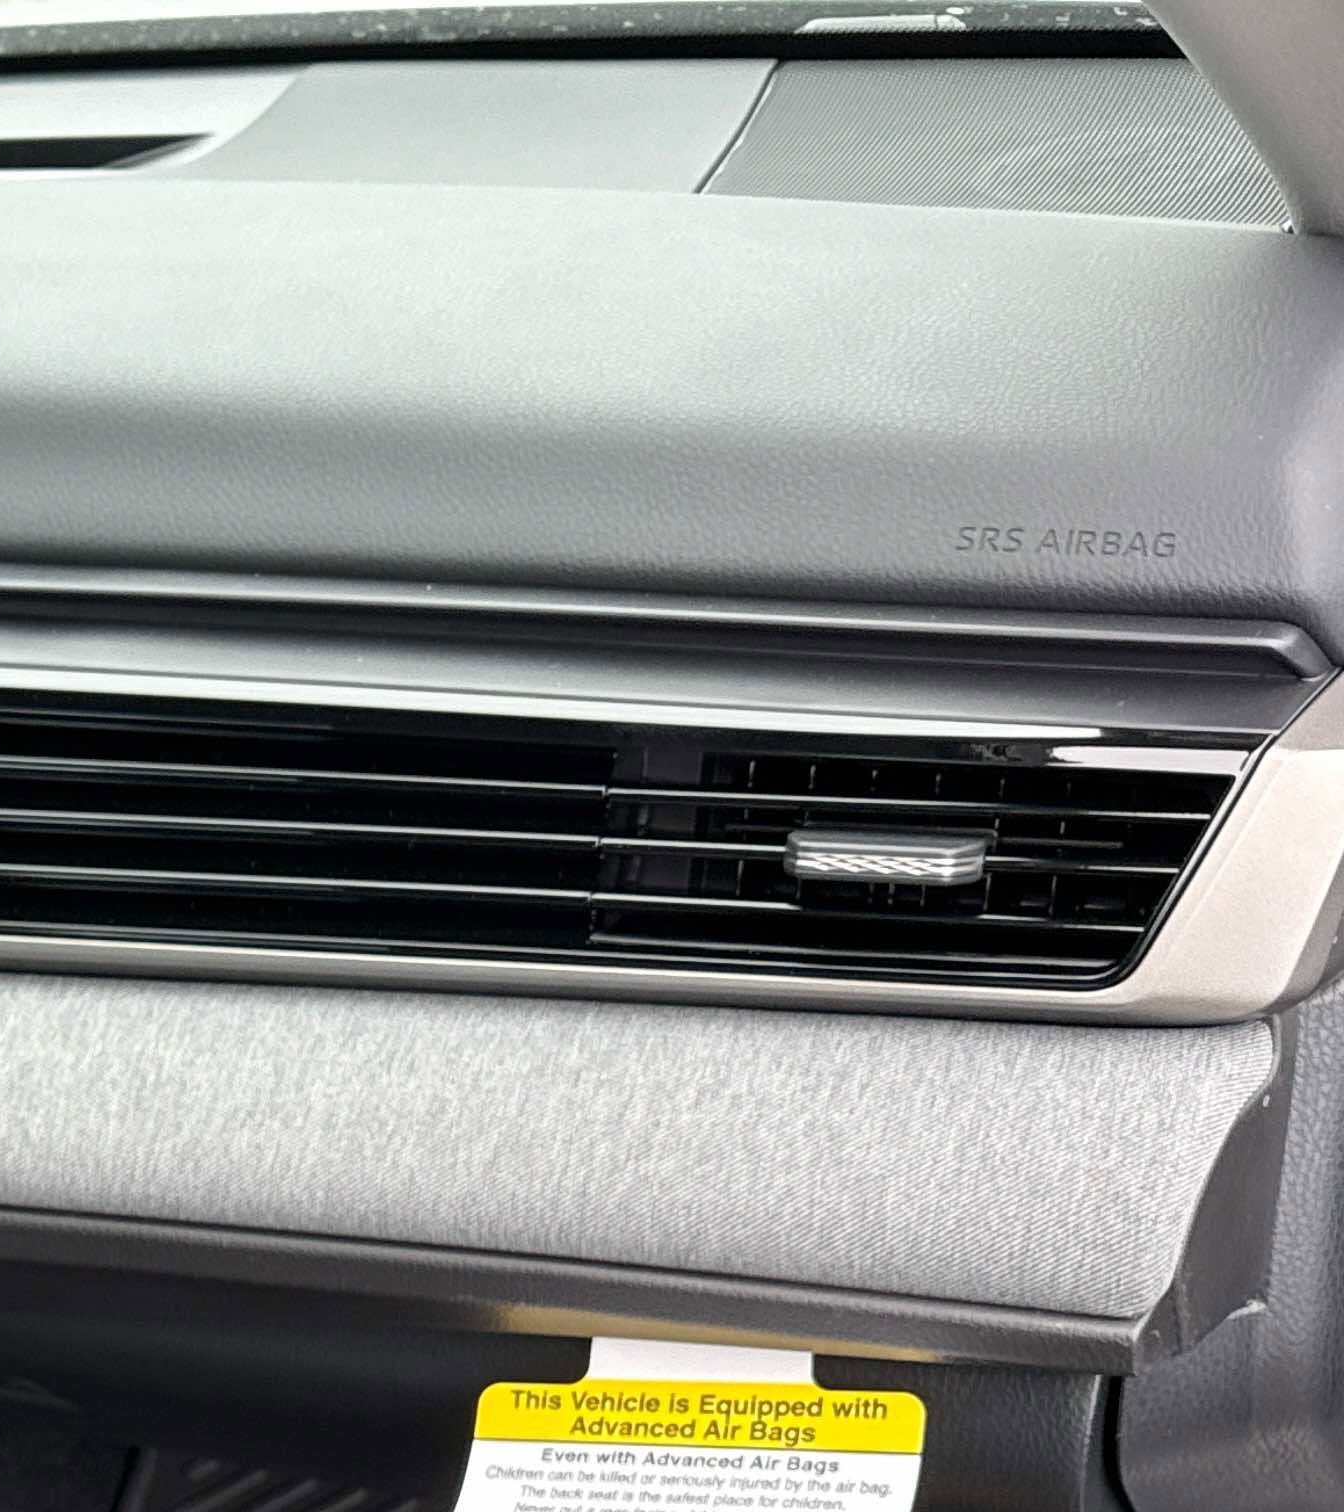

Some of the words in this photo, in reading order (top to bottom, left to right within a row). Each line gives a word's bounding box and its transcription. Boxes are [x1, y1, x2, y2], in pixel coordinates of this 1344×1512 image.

[956, 526, 1024, 552] SRS
[1037, 528, 1177, 558] AIRBAG
[511, 1389, 562, 1410] This
[570, 1391, 660, 1413] Vehicle
[669, 1393, 690, 1414] is
[699, 1394, 824, 1423] Equipped
[832, 1397, 888, 1419] with
[569, 1416, 696, 1438] Advanced
[704, 1419, 742, 1441] Air
[750, 1420, 816, 1447] Bags
[541, 1448, 588, 1463] Even
[596, 1449, 636, 1465] with
[642, 1451, 744, 1469] Advanced
[750, 1455, 781, 1471] Air
[786, 1456, 841, 1476] Bags
[486, 1464, 544, 1481] Children
[548, 1470, 573, 1481] can
[577, 1470, 595, 1482] be
[599, 1470, 636, 1484] killed
[640, 1474, 655, 1485] or
[659, 1475, 724, 1491] seriously
[730, 1476, 780, 1492] injured
[784, 1478, 803, 1493] by
[808, 1478, 831, 1492] the
[836, 1480, 855, 1493] air
[860, 1481, 893, 1498] bag.
[520, 1485, 546, 1498] The
[550, 1486, 583, 1500] back
[588, 1489, 618, 1501] seat
[622, 1490, 634, 1502] is
[639, 1490, 662, 1503] the
[665, 1492, 710, 1505] safest
[713, 1493, 753, 1508] place
[758, 1495, 777, 1508] for
[782, 1496, 847, 1511] children.
